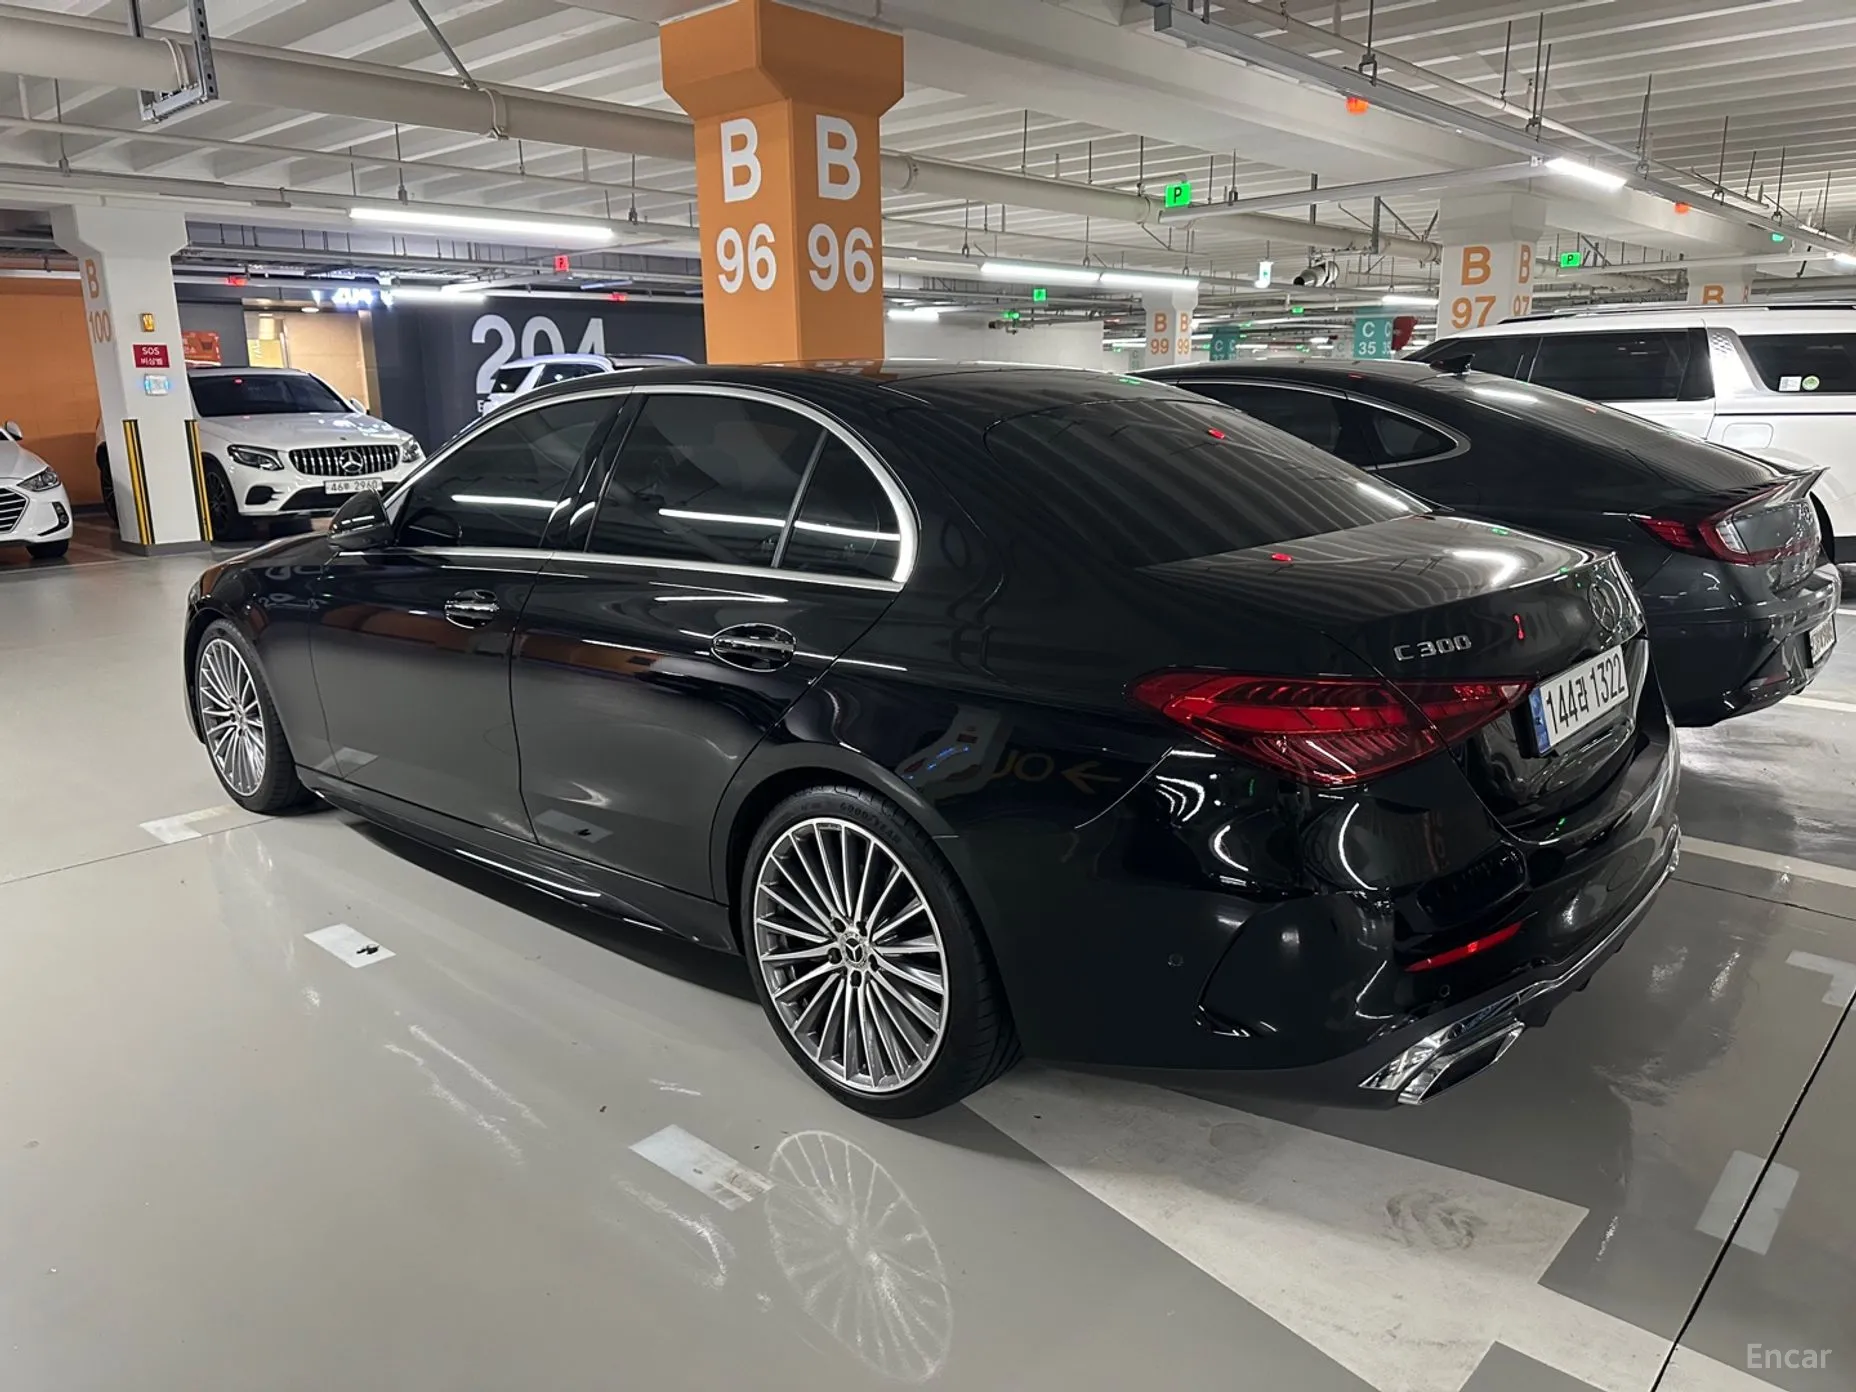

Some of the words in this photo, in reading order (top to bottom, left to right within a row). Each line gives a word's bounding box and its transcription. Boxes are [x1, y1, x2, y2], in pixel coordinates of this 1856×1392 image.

[721, 118, 762, 203] B
[816, 114, 861, 200] B
[1173, 186, 1183, 203] P
[717, 223, 777, 294] 96
[808, 223, 874, 293] 96
[1461, 245, 1492, 286] B
[1518, 244, 1531, 284] B
[85, 259, 99, 298] B
[89, 309, 111, 344] 100
[1154, 312, 1167, 333] B
[1180, 312, 1188, 332] B
[1451, 295, 1497, 329] 97
[1362, 321, 1376, 338] C
[141, 346, 160, 356] SOS
[1150, 338, 1169, 355] 99
[1177, 338, 1190, 354] 99
[1214, 340, 1224, 352] C
[1358, 341, 1376, 355] 35
[1393, 645, 1415, 661] C
[1420, 634, 1472, 658] 300
[1547, 676, 1590, 734] 144라
[1590, 653, 1625, 707] 1322
